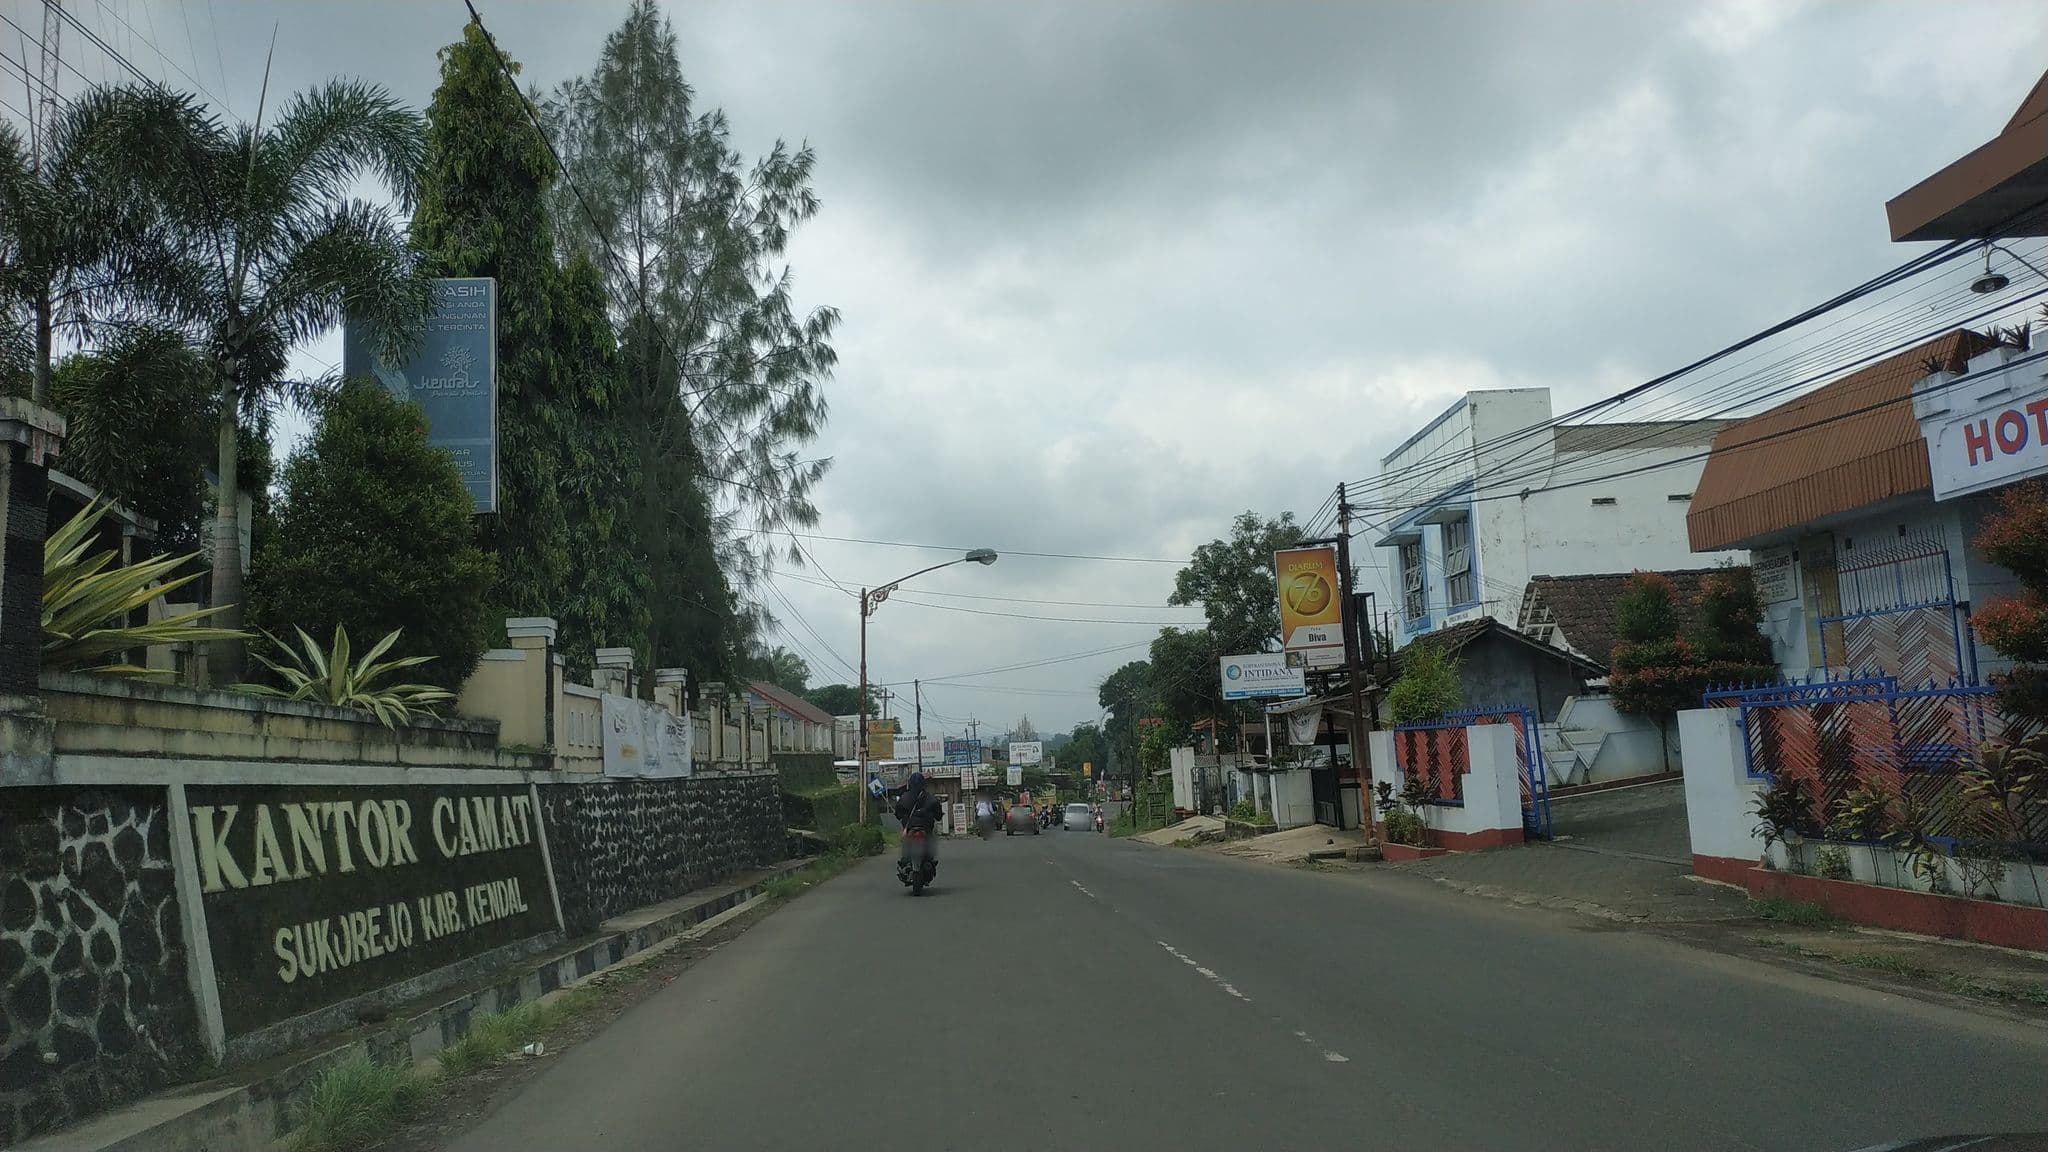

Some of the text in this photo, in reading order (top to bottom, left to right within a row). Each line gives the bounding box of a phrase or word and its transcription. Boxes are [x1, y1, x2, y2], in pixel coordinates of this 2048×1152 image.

[1308, 632, 1327, 642] Diva
[1243, 668, 1293, 679] INTIDANA
[190, 795, 532, 894] KANTOR CAMAT
[466, 877, 528, 927] KENDAL
